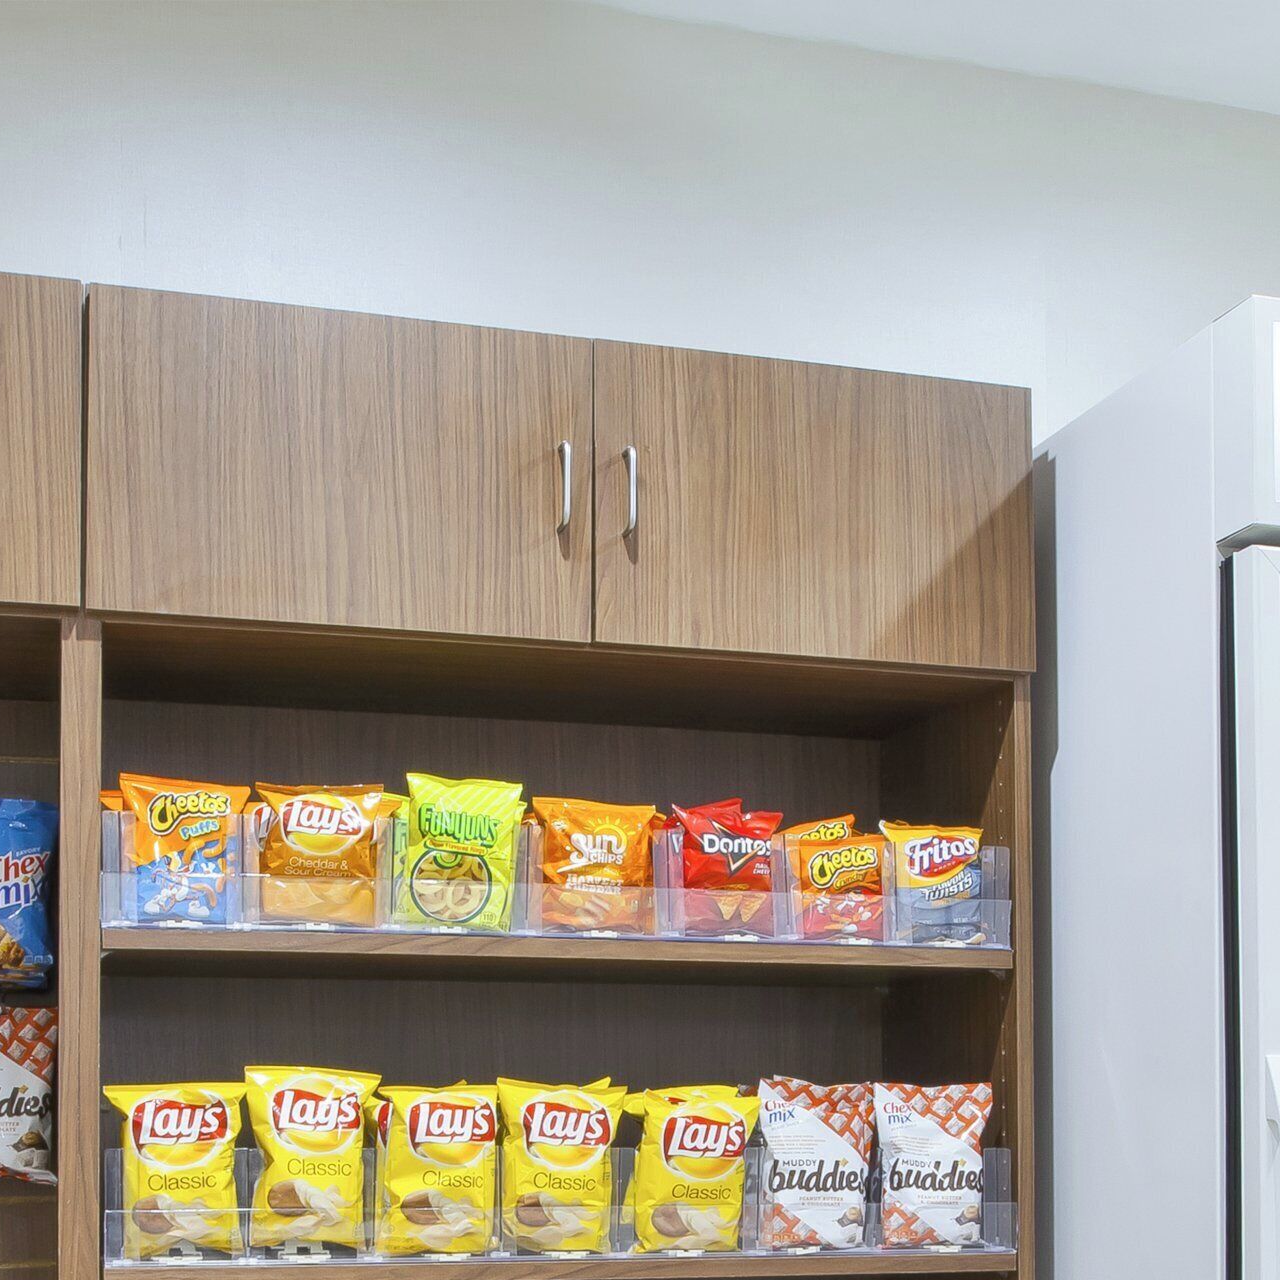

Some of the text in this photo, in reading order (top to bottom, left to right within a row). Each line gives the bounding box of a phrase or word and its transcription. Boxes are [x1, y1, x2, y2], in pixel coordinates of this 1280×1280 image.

[151, 792, 228, 832] Cheetos
[287, 801, 363, 835] Lay's
[180, 820, 219, 840] Puffs
[570, 832, 628, 864] Sun
[704, 834, 772, 856] Doritos
[289, 857, 349, 870] Cheddar &
[590, 851, 624, 865] CHIPS
[905, 837, 975, 875] Fritos
[284, 866, 352, 877] Sour Cream
[813, 848, 876, 885] Cheetos
[567, 874, 624, 887] HARVEST
[920, 874, 972, 900] TWISTS
[933, 871, 965, 891] FLAVOR
[277, 1088, 358, 1132] Lay's
[769, 1107, 795, 1123] mix
[883, 1102, 913, 1114] Chex
[139, 1099, 224, 1145] Lay's
[409, 1100, 492, 1144] Lay's
[529, 1103, 605, 1146] Lay's
[888, 1112, 913, 1125] mix
[668, 1117, 744, 1159] Lay's
[287, 1158, 352, 1178] Classic
[782, 1159, 818, 1168] MUDDY
[902, 1159, 932, 1168] MUDDY
[147, 1173, 217, 1191] Classic
[422, 1170, 484, 1189] Classic
[533, 1172, 597, 1191] Classic
[672, 1184, 731, 1200] Classic
